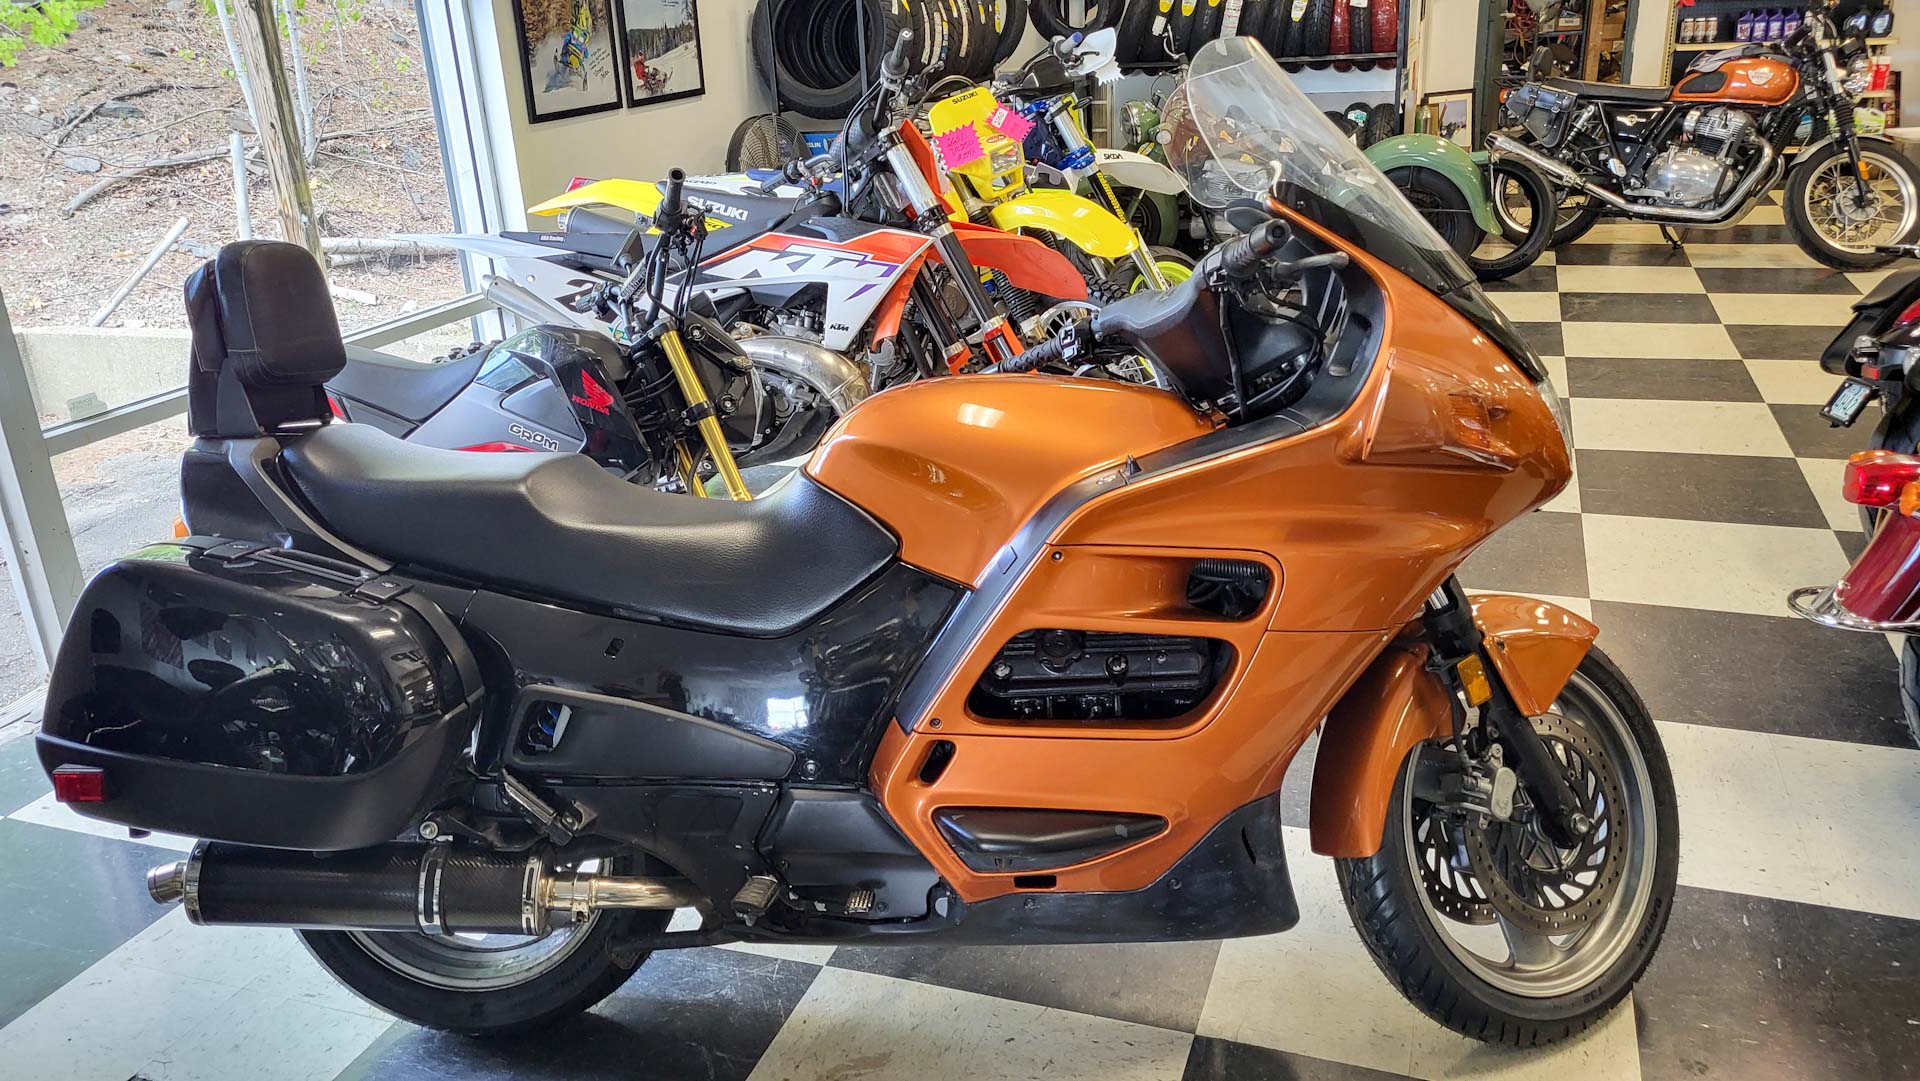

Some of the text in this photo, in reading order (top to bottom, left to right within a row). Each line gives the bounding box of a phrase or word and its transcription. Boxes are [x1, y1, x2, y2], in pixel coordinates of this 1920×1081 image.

[952, 91, 978, 104] SUZUKI
[687, 195, 748, 222] SUZUKI
[702, 244, 899, 292] KTM
[829, 323, 849, 332] KTM
[571, 394, 610, 416] HONDA
[509, 423, 559, 452] GROM
